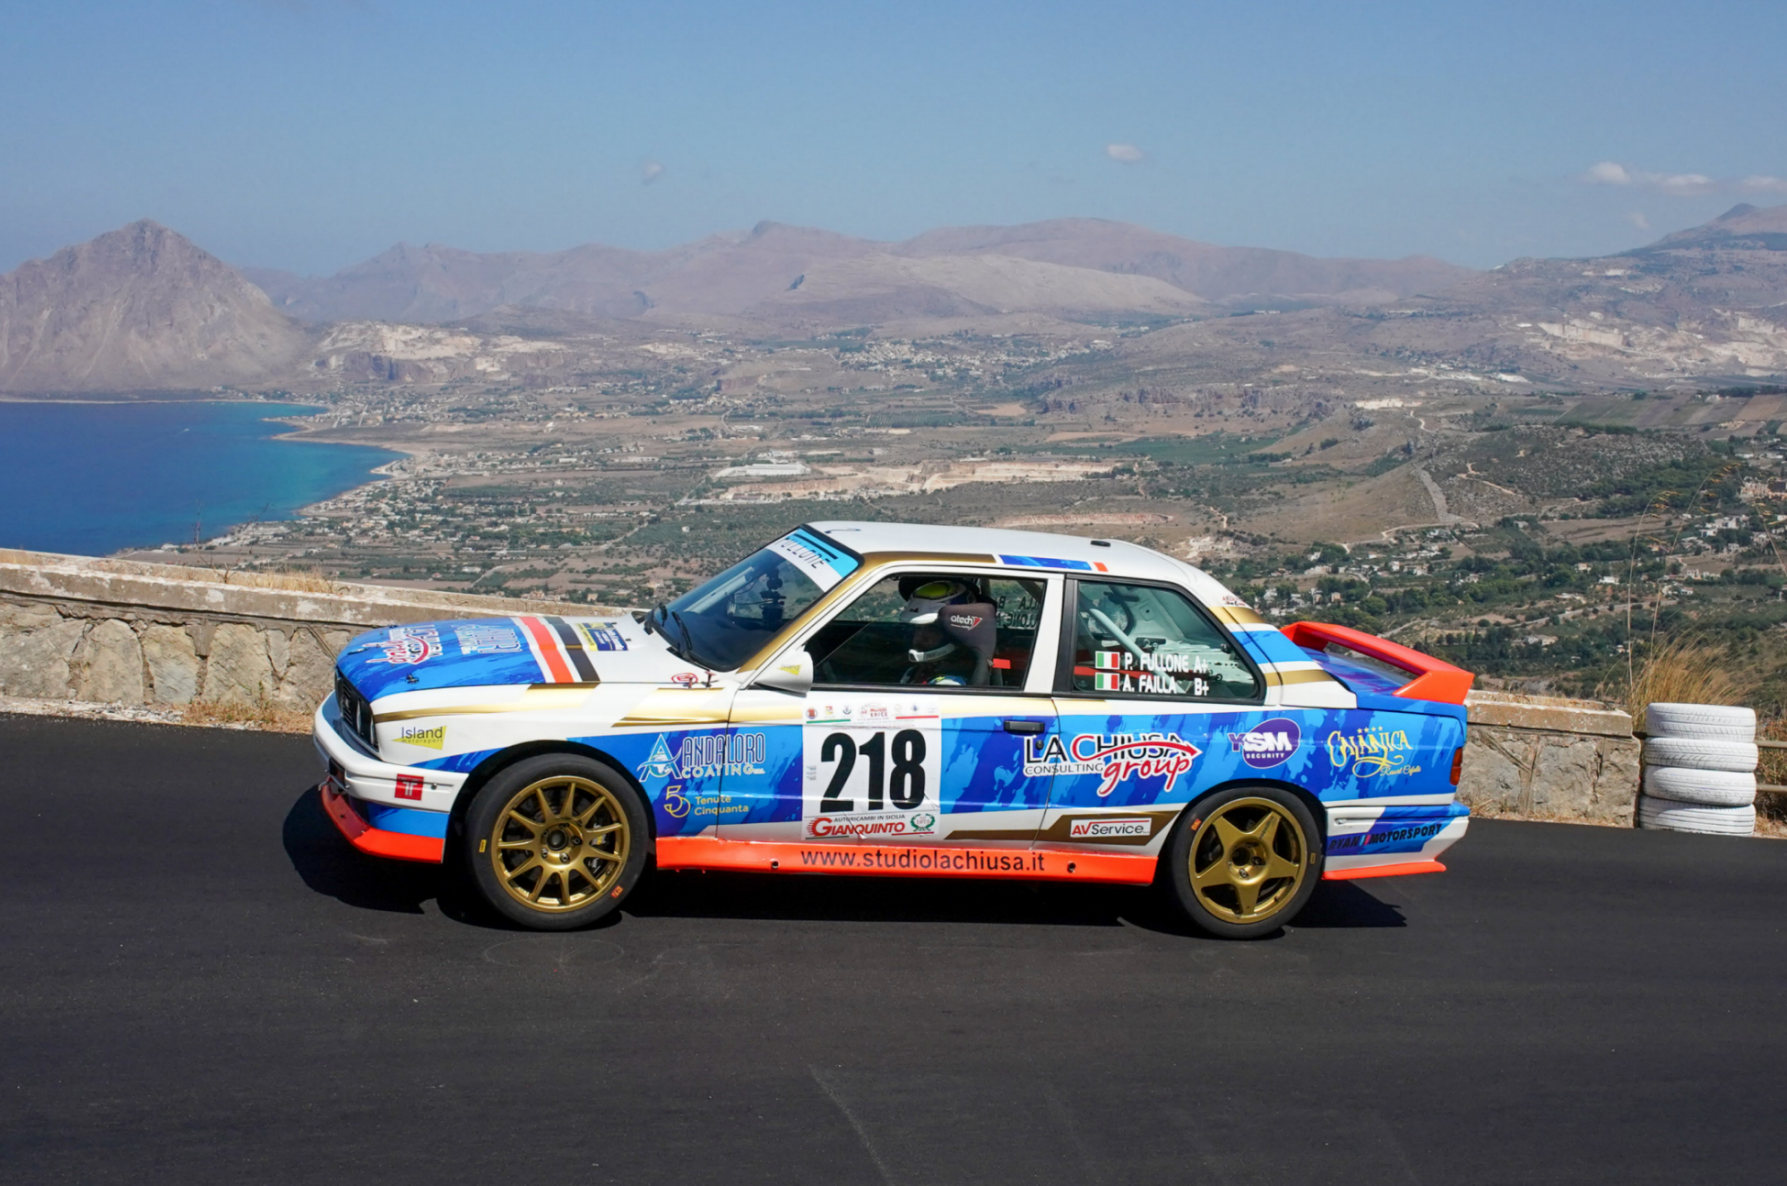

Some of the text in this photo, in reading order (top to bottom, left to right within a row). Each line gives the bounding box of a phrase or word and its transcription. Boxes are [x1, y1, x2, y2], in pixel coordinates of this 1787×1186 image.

[1124, 653, 1209, 673] P. FULLONE A+
[1122, 675, 1209, 696] A. FAILLA B+
[682, 732, 766, 768] ANDALORO
[1025, 733, 1192, 763] LA CHIUSA
[1227, 731, 1293, 752] YSM
[681, 763, 753, 778] COATING
[820, 729, 926, 813] 218
[1024, 763, 1103, 775] CONSULTING
[1097, 755, 1191, 796] group
[694, 804, 749, 816] Cinquanta
[695, 795, 732, 805] Tenute
[810, 817, 906, 837] GIANQUINTO
[834, 815, 877, 823] AUTORICAMBI
[1368, 824, 1442, 846] MOTORSPORT
[801, 849, 1045, 871] www.studiolachiusa.it
